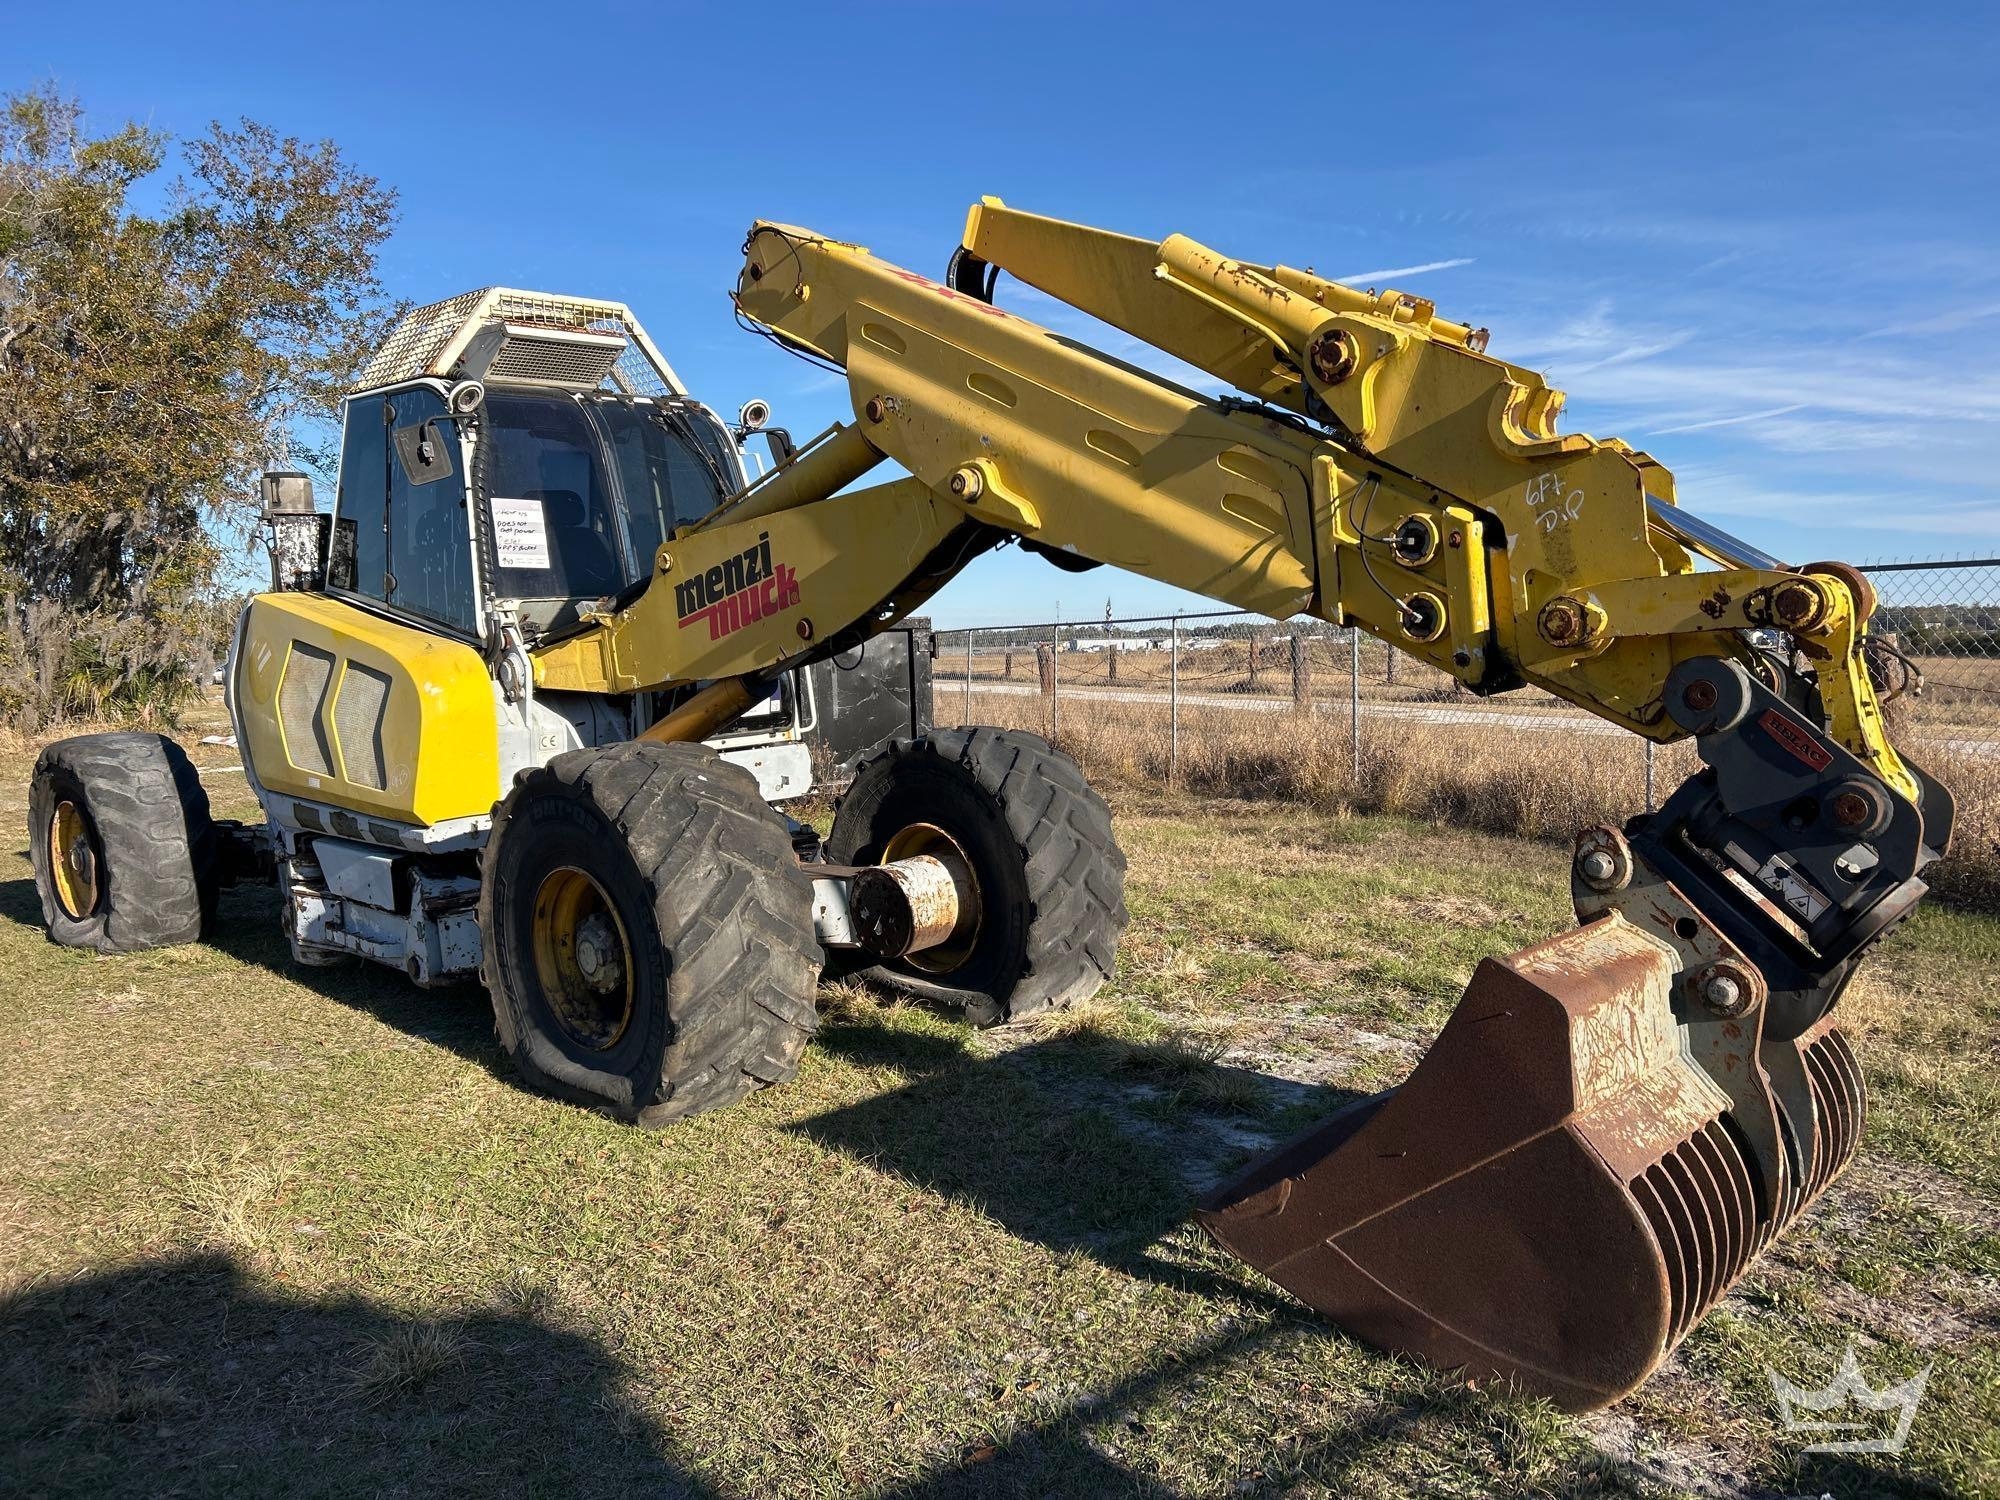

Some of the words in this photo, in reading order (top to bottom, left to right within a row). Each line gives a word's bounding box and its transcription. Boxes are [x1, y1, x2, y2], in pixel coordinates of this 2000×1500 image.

[674, 531, 774, 619] menzi
[679, 563, 801, 641] muck
[541, 735, 556, 747] CE
